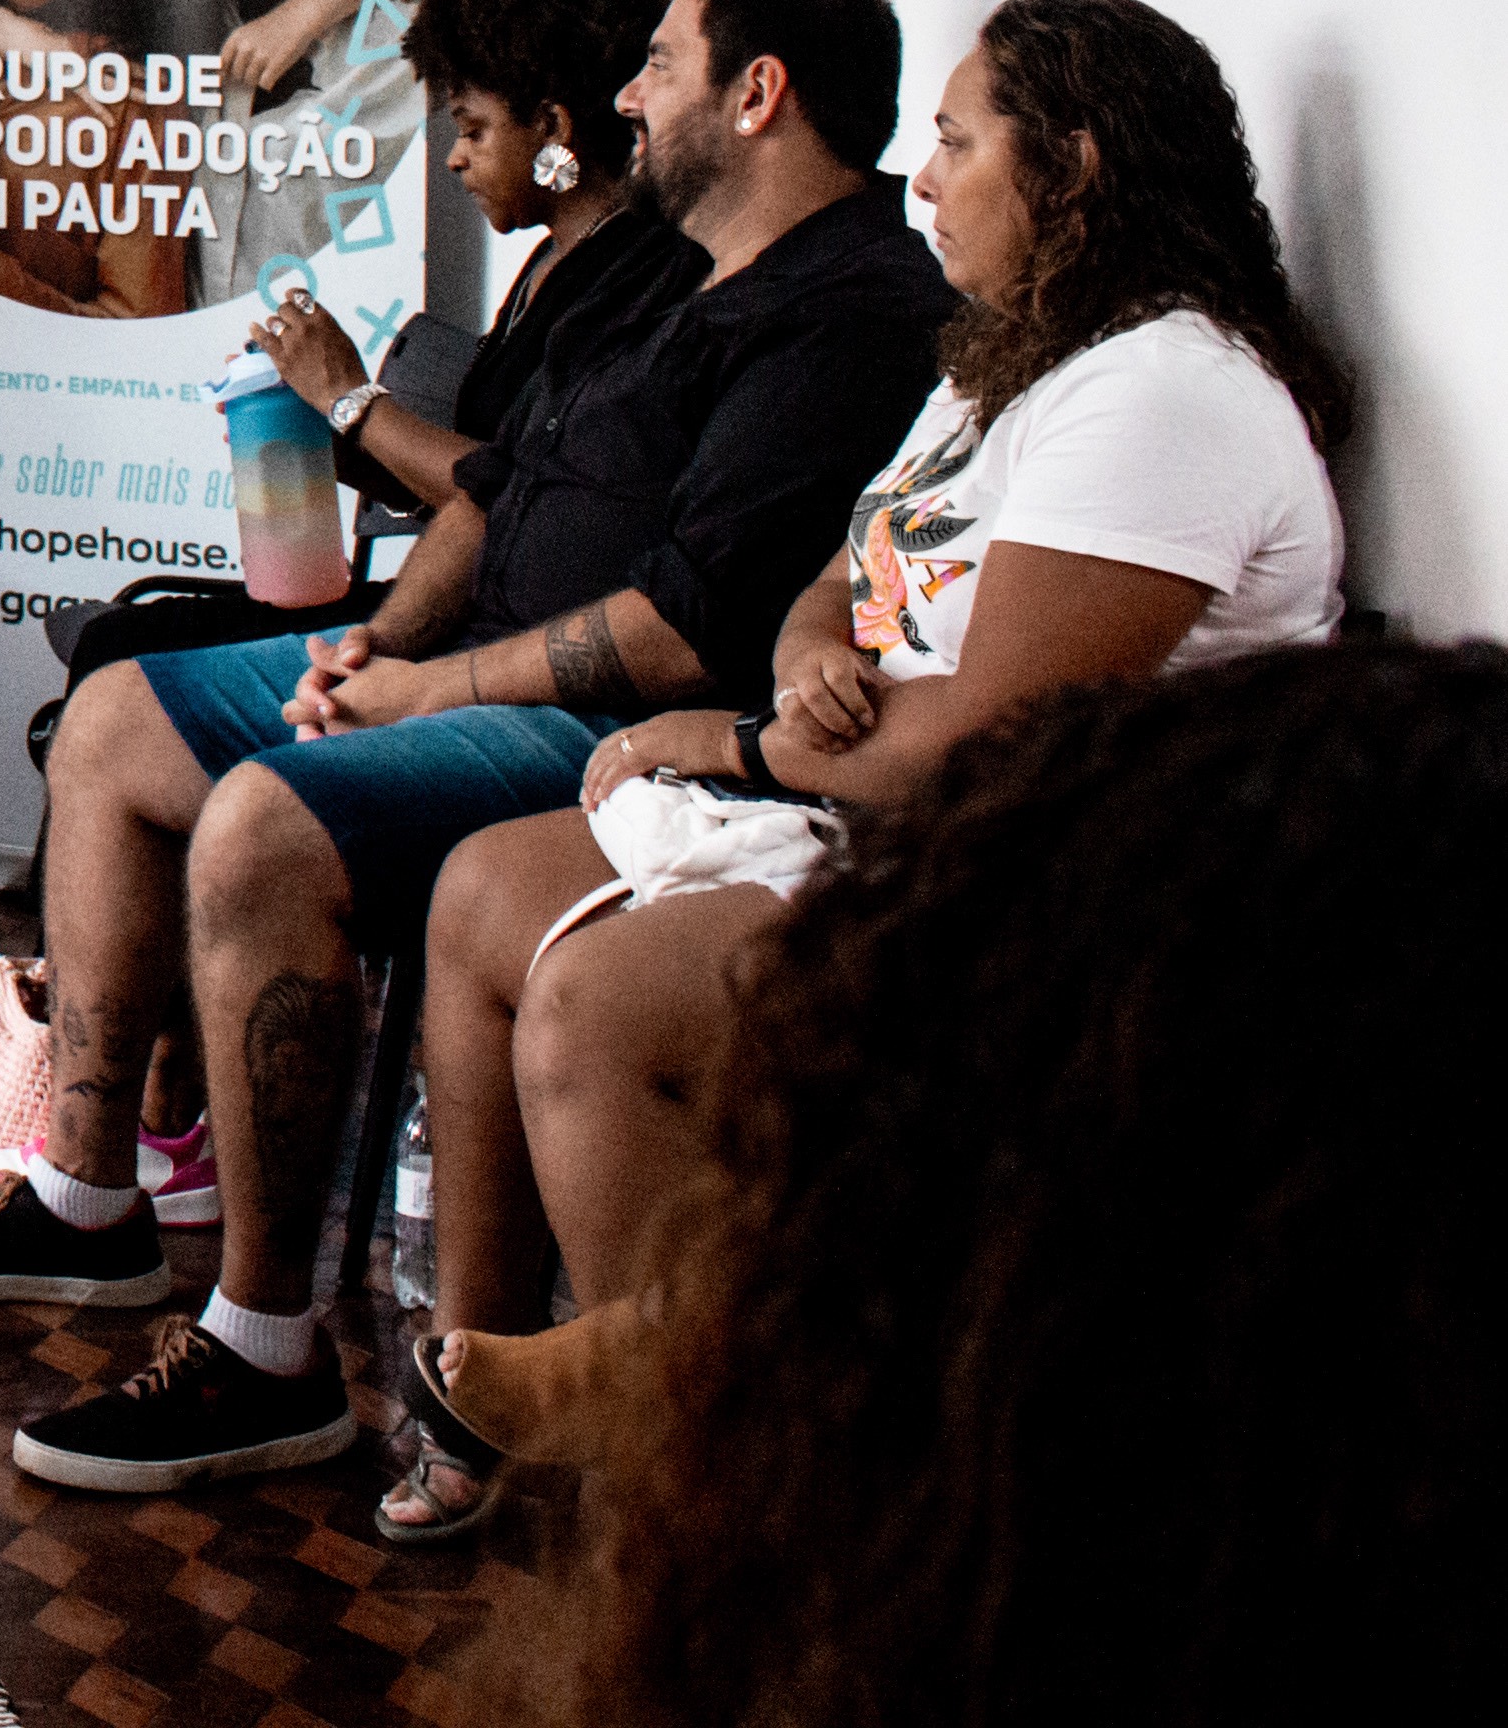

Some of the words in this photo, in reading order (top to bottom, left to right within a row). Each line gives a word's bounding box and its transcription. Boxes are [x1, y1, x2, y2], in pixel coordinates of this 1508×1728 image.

[145, 53, 223, 108] DE
[118, 109, 375, 194] ADOÇÃO
[22, 179, 219, 240] PAUTA
[68, 375, 162, 400] EMPATIA
[15, 442, 105, 498] saber
[117, 456, 191, 507] mais
